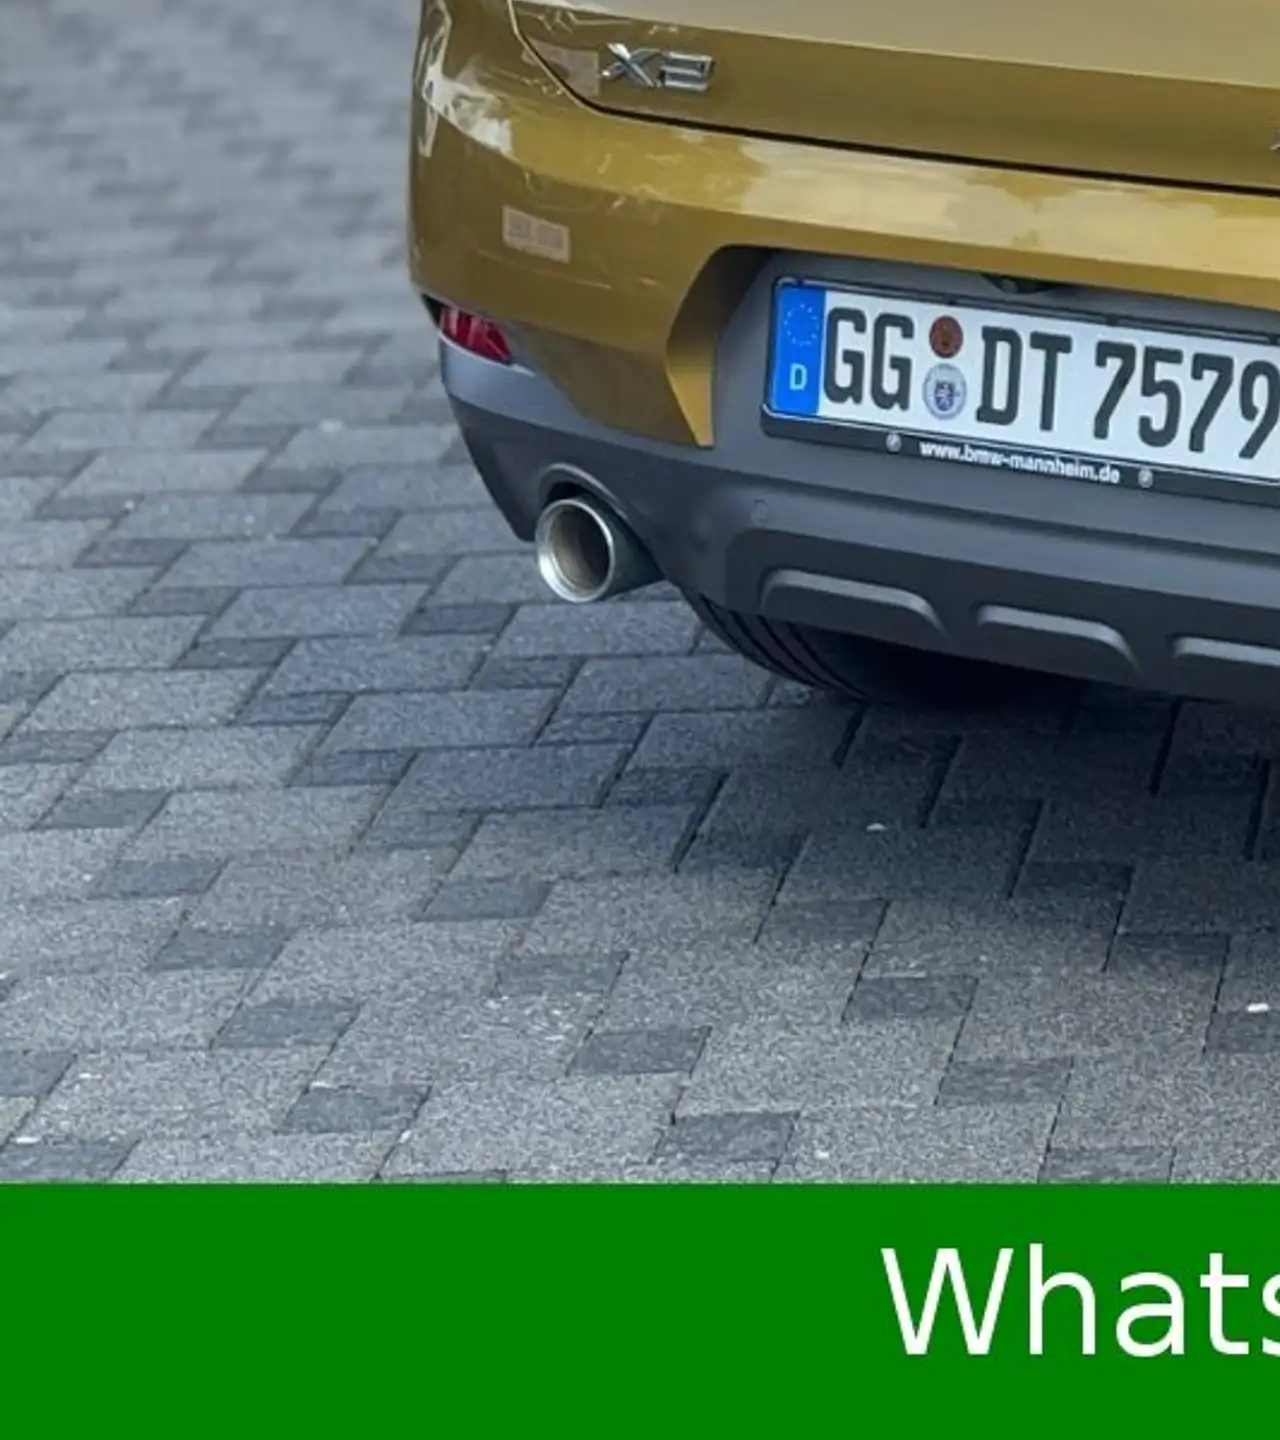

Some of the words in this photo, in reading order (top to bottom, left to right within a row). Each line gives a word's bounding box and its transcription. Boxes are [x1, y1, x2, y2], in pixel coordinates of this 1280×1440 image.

[602, 42, 713, 91] X2
[788, 362, 808, 391] D
[823, 306, 915, 412] GG
[976, 325, 1073, 432] DT
[918, 440, 1121, 485] www.bmw-mannheim.de
